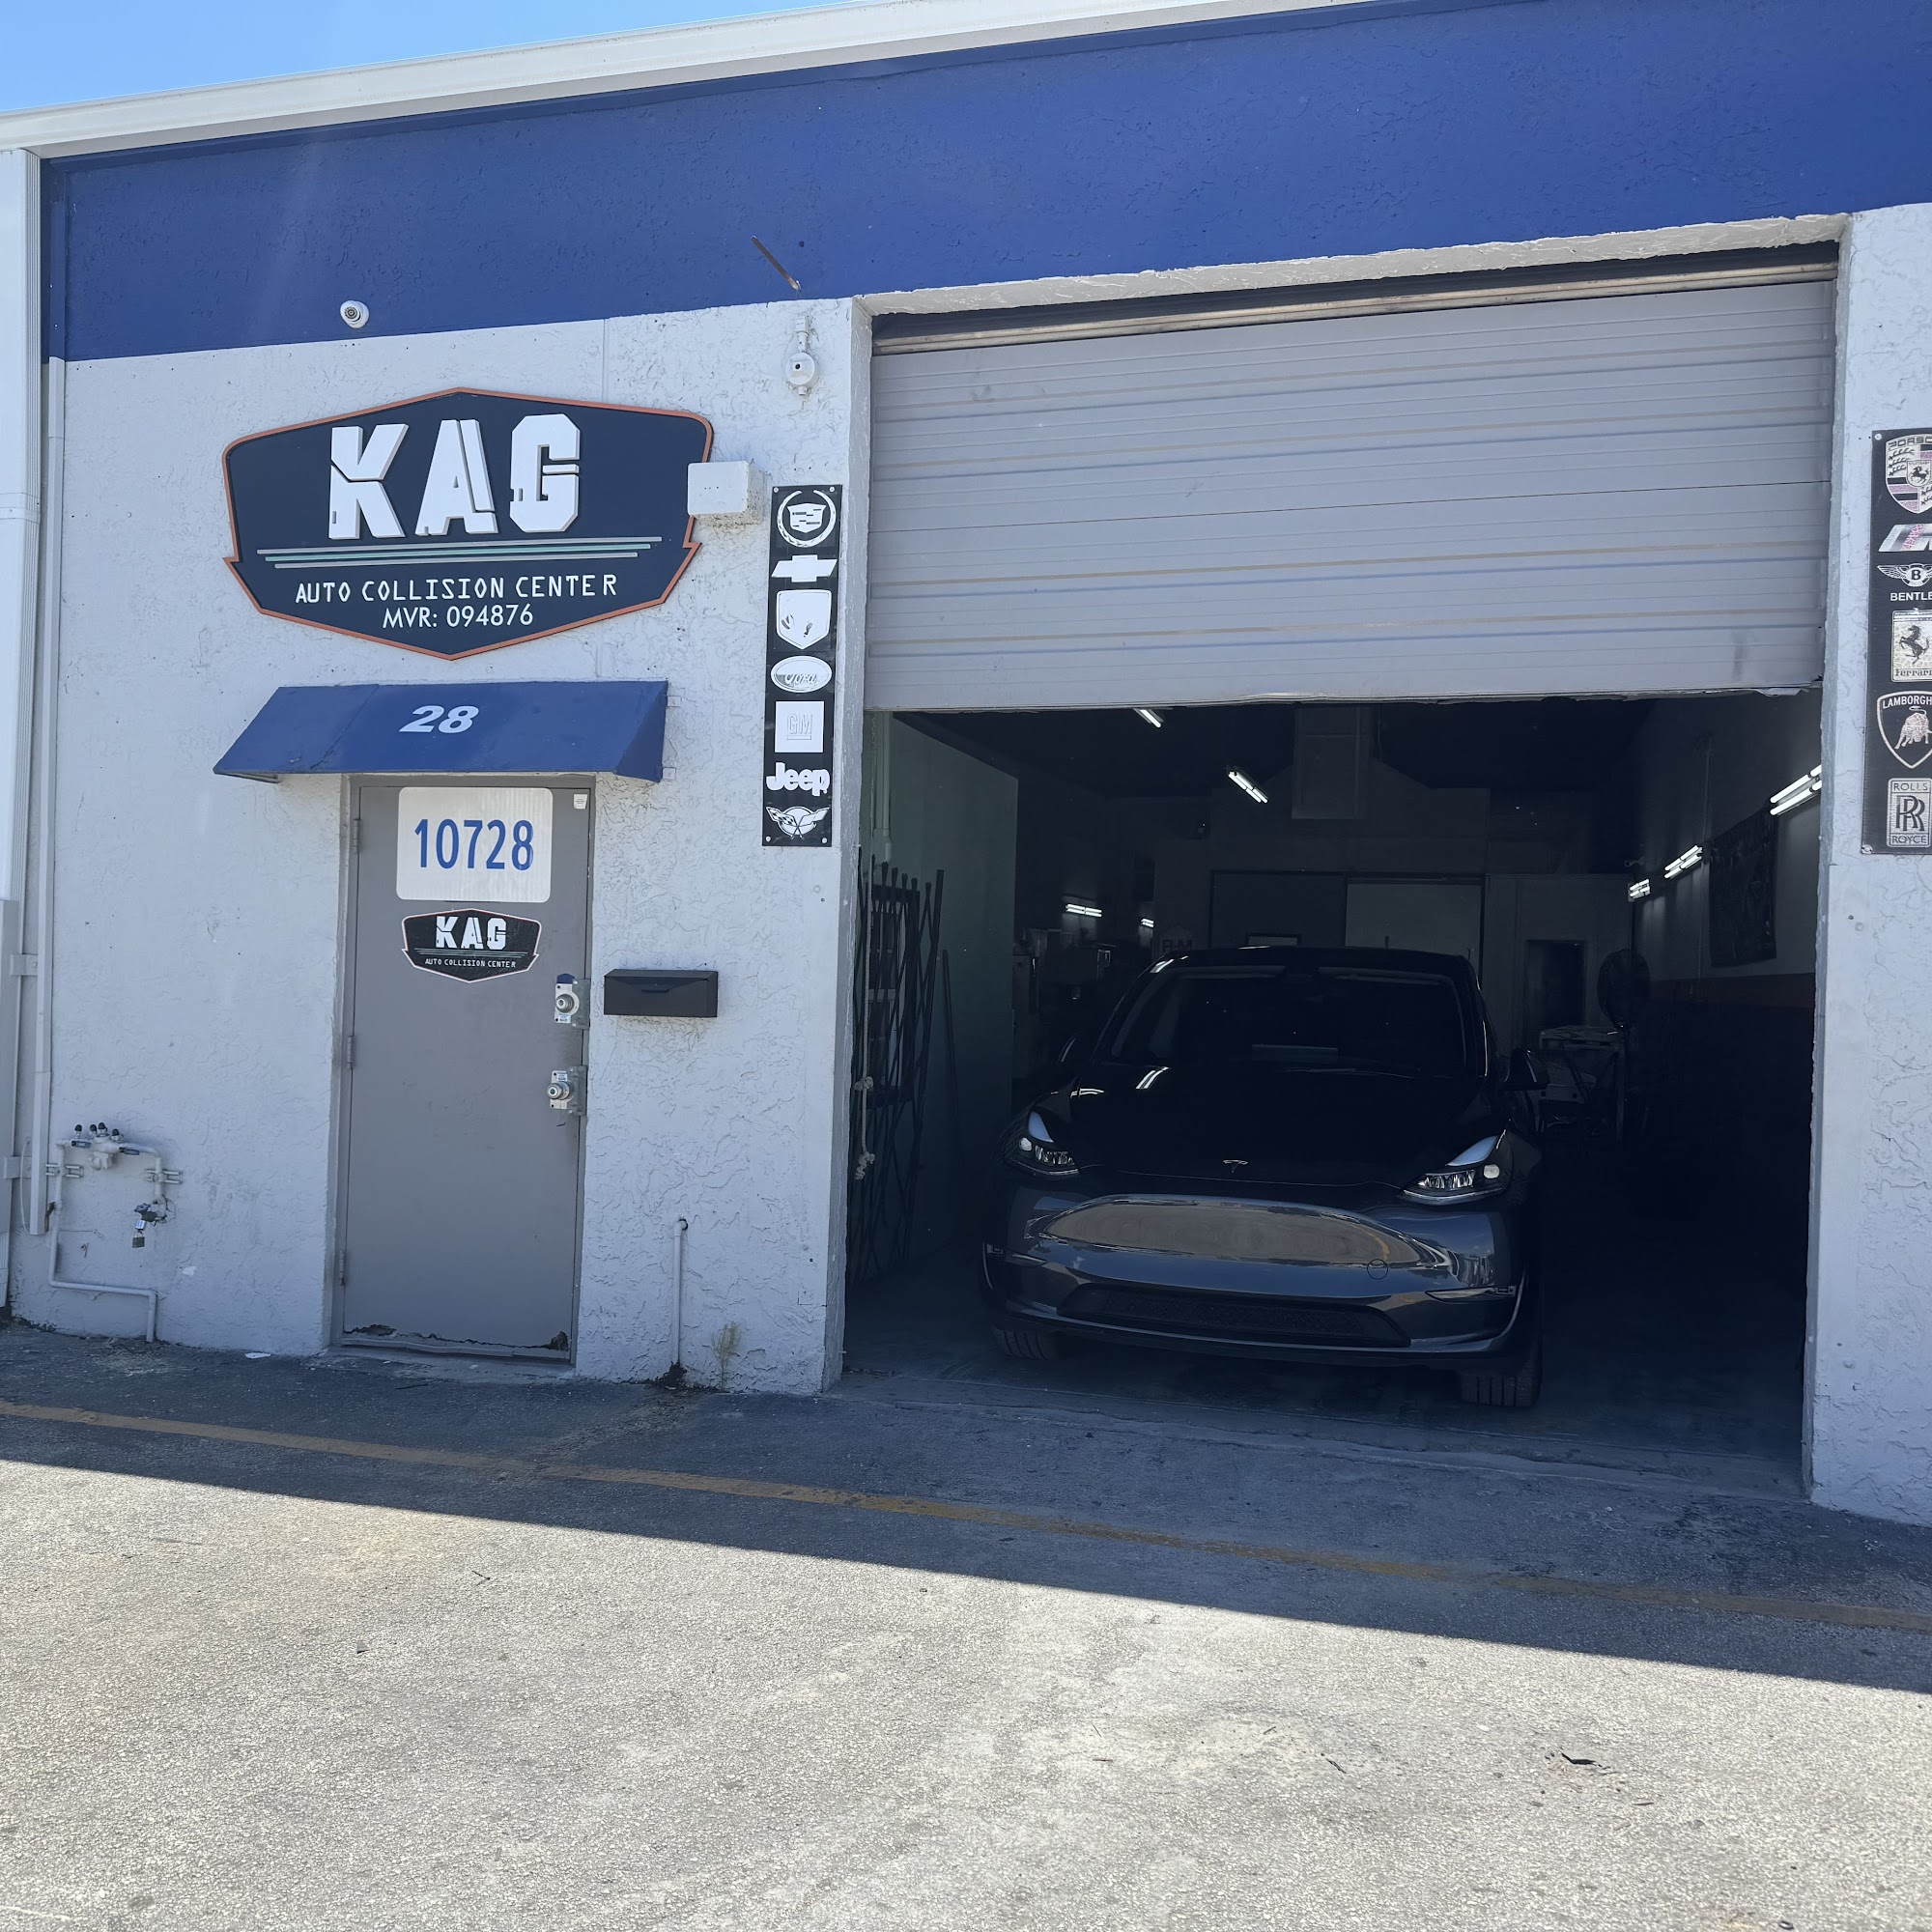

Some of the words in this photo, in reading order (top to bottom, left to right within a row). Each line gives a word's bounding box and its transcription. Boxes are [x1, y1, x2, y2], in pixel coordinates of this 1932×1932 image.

[328, 413, 580, 540] KAG
[1911, 569, 1921, 581] B
[296, 582, 351, 604] AUTO
[361, 576, 505, 602] COLLISION
[515, 575, 617, 598] CENTER
[383, 607, 439, 628] MVR:
[446, 604, 533, 628] 094876
[399, 705, 479, 734] 28
[786, 713, 813, 735] GM
[766, 762, 831, 797] Jeep
[1893, 782, 1928, 791] ROLLS
[414, 818, 534, 871] 10728
[1891, 835, 1927, 844] ROYCE
[436, 916, 507, 951] KAG
[444, 958, 486, 967] COLLISION
[487, 960, 517, 969] CENTER
